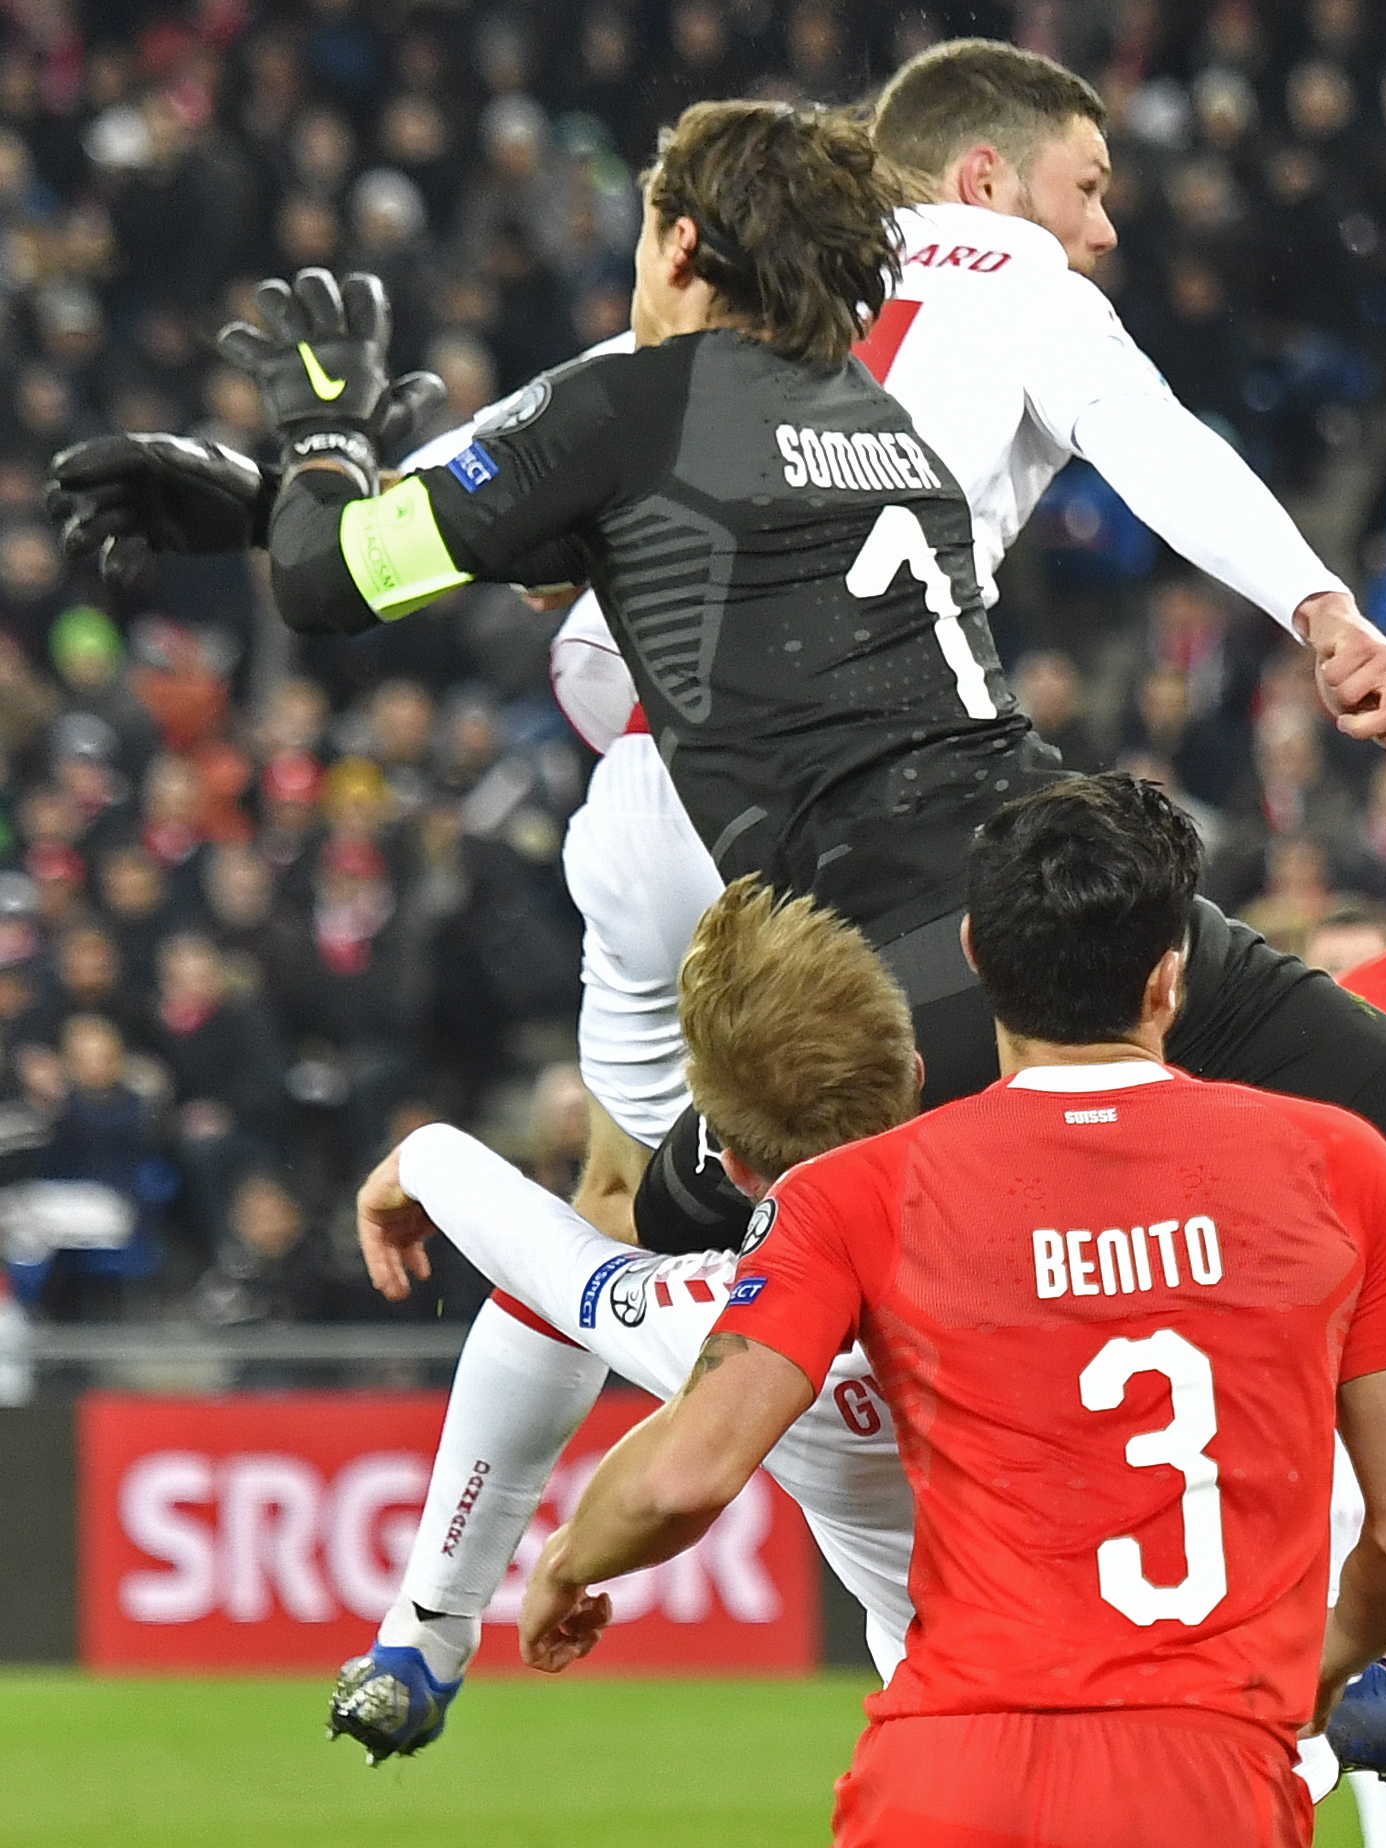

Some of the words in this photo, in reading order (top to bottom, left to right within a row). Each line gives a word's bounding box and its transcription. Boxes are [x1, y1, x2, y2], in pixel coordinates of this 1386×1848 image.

[775, 424, 942, 490] SOMMER
[845, 504, 998, 720] 1
[1064, 1107, 1118, 1124] SUISSE
[1032, 1215, 1224, 1300] BENITO
[833, 1374, 883, 1437] G
[441, 1460, 491, 1557] DANMARK
[1079, 1328, 1229, 1627] 3
